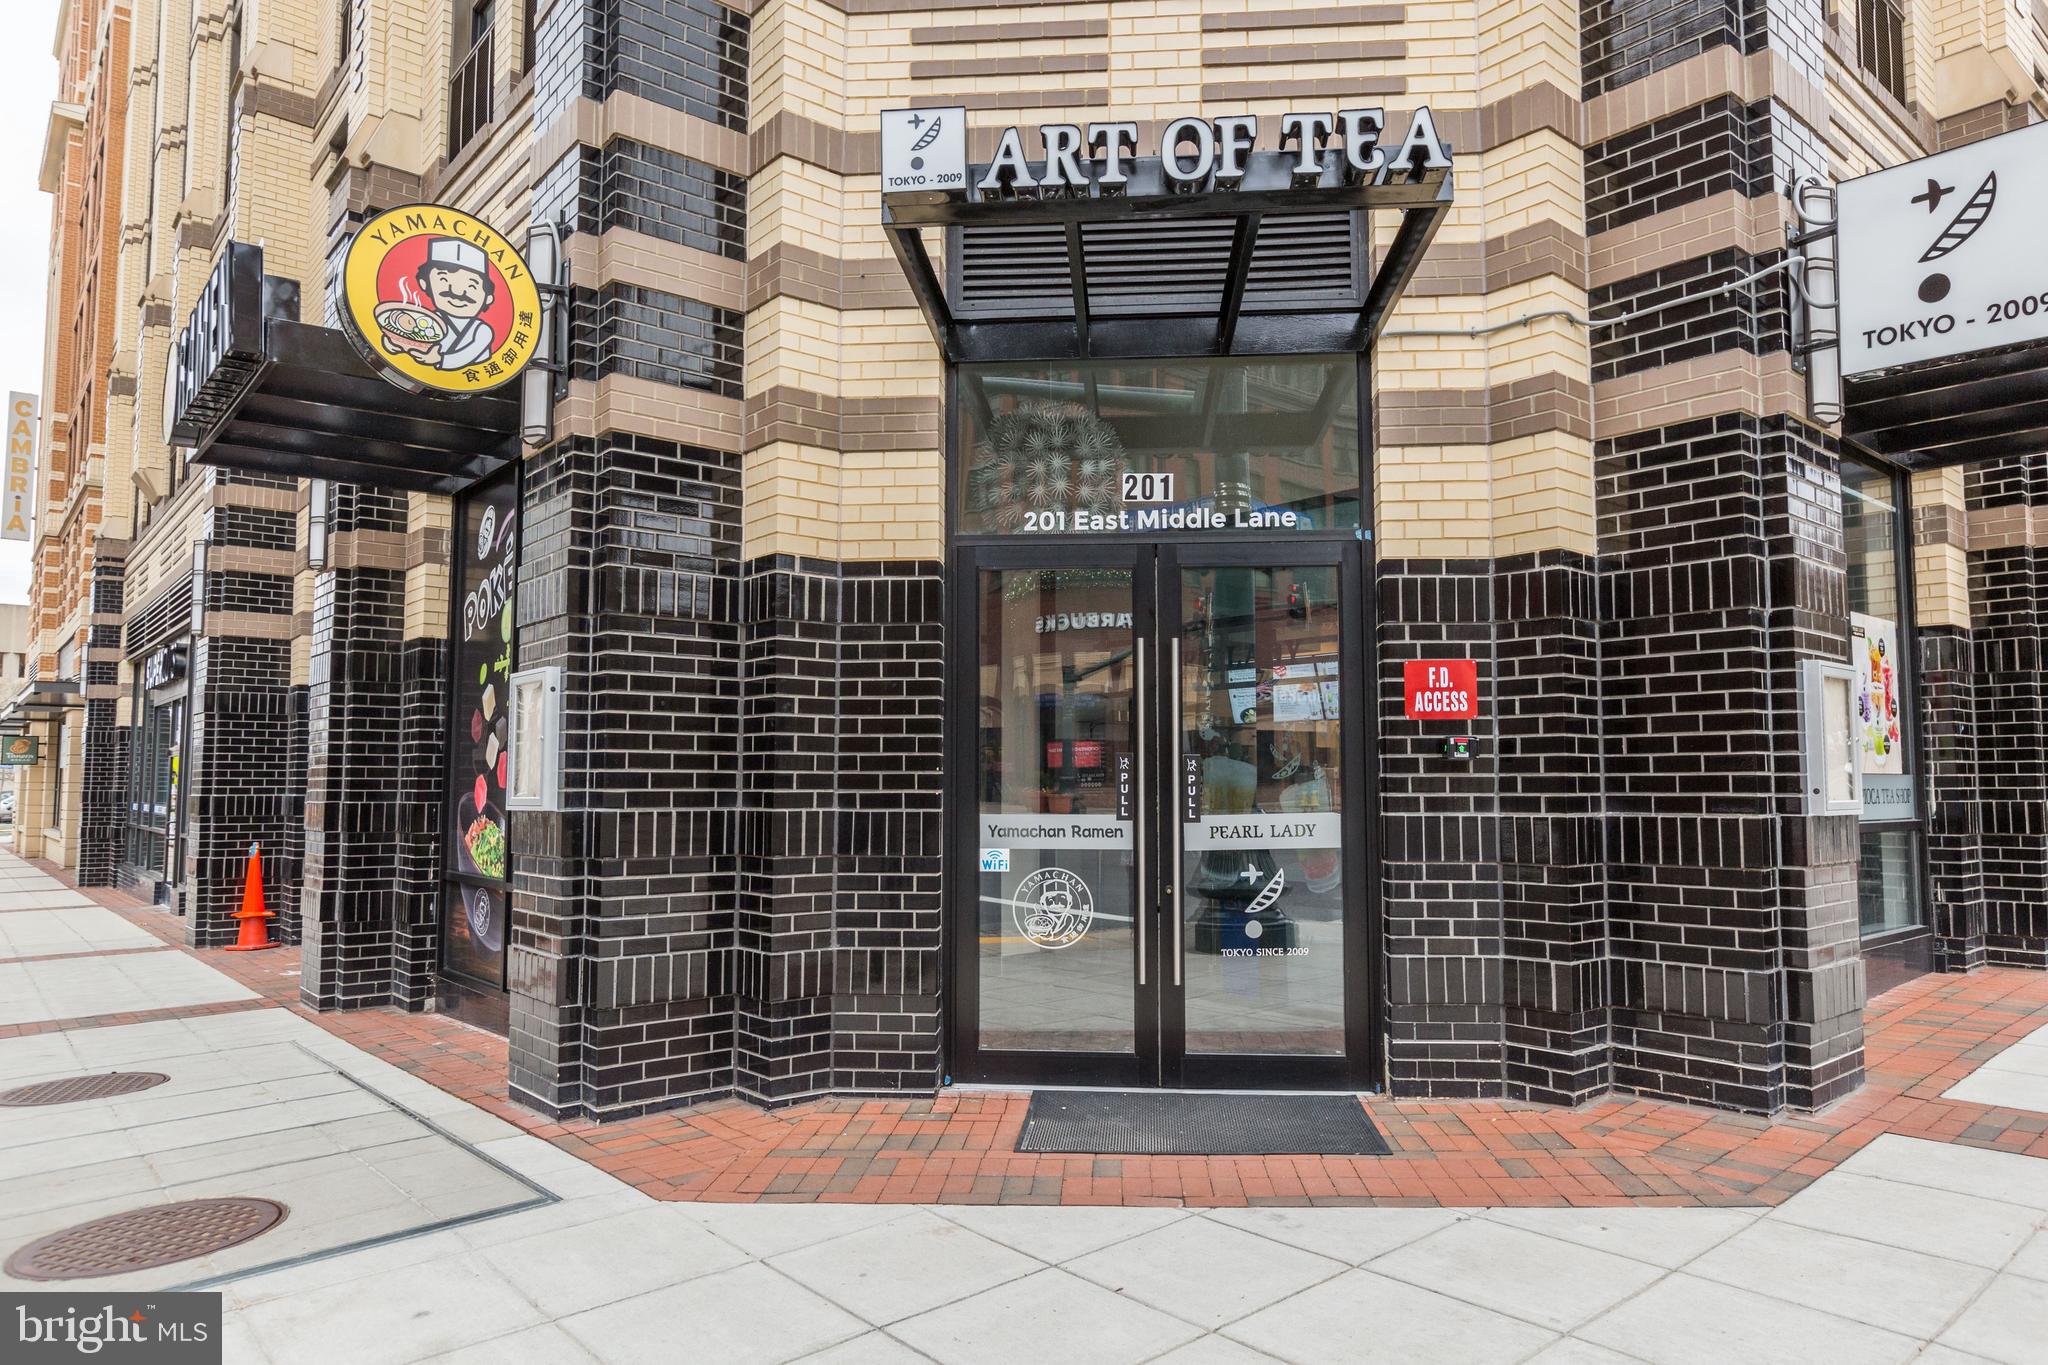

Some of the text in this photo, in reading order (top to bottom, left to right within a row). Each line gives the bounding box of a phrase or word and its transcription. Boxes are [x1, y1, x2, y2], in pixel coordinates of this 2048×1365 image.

[976, 105, 1453, 188] ART OF TEA
[888, 175, 926, 187] TOKYO
[937, 172, 963, 184] 2009
[370, 213, 524, 281] YAMACHAN
[1862, 314, 1956, 349] TOKYO
[461, 310, 534, 383] 食通御用達
[1124, 474, 1172, 500] 201
[1023, 507, 1297, 531] 201 East Middle Lane
[1428, 667, 1454, 688] F.D.
[1414, 691, 1469, 712] ACCESS
[1120, 772, 1129, 816] PULL
[1187, 774, 1196, 818] PULL
[988, 824, 1124, 839] Yamachan Ramen
[1209, 823, 1317, 839] PEARL LADY
[982, 859, 1008, 870] WiFi
[1021, 871, 1084, 893] YAMACHAN
[1220, 947, 1310, 957] TOKYO SINCE 2009
